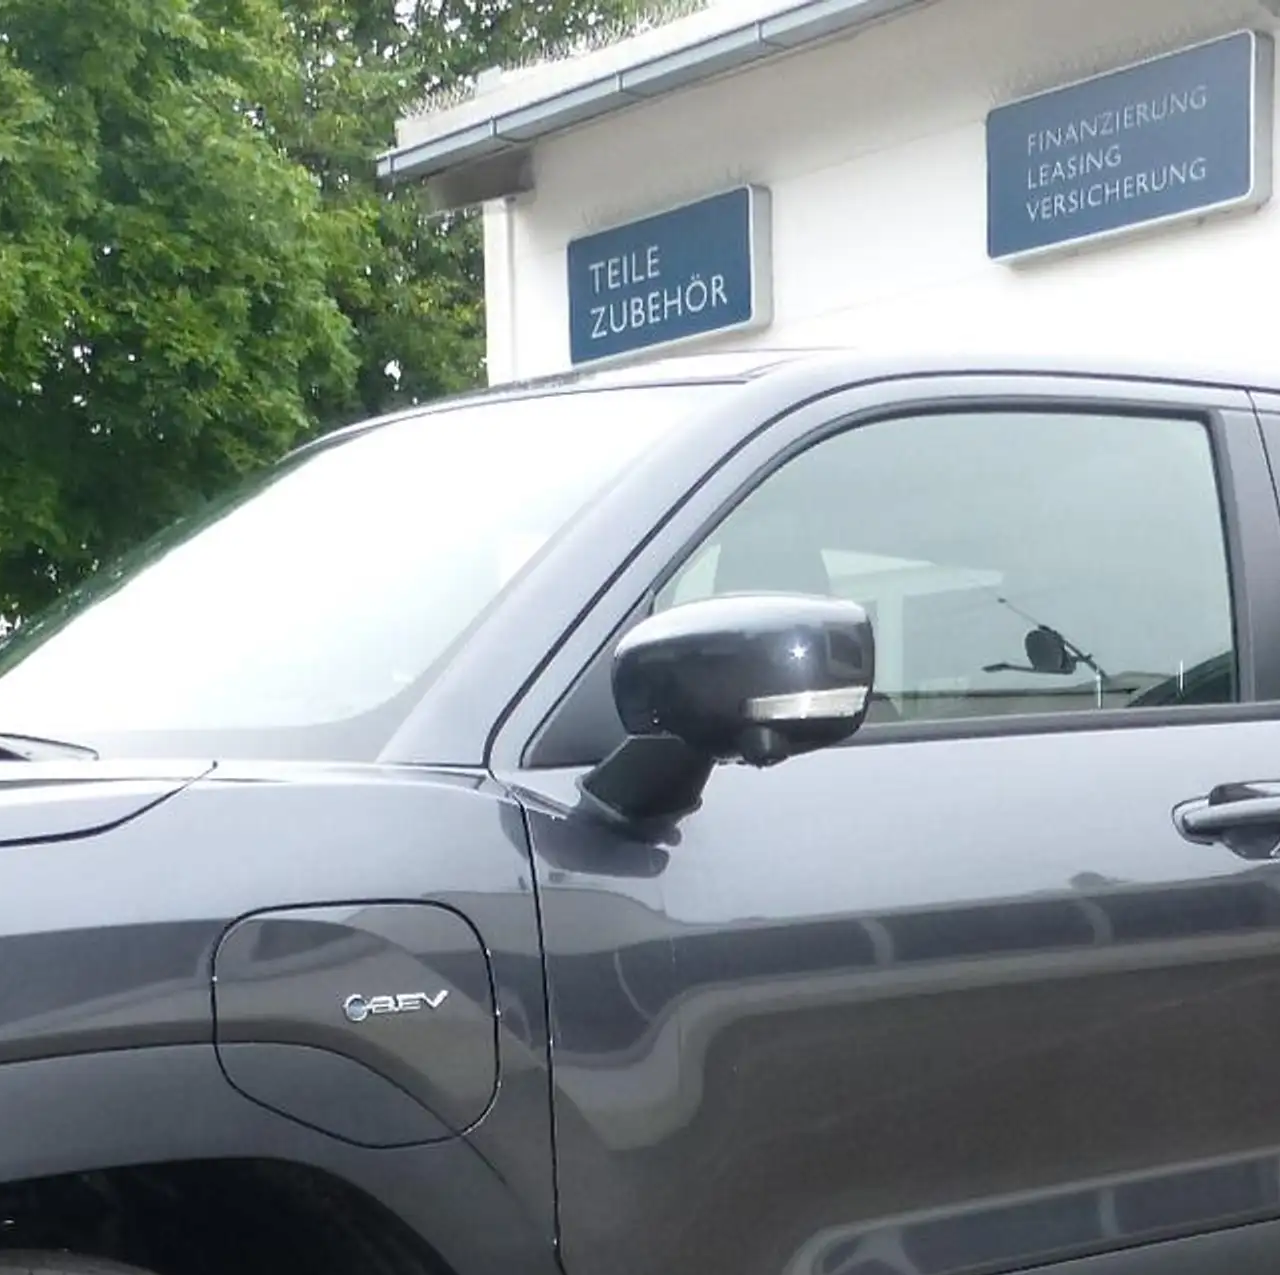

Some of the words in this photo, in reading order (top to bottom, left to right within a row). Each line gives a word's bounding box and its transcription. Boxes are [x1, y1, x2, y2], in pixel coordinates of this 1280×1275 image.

[1026, 85, 1207, 156] FINANZIERUNG
[1025, 157, 1207, 222] VERSICHERUNG
[1026, 145, 1122, 190] LEASING
[588, 244, 661, 294] TEILE
[589, 272, 728, 339] ZUBEHÖR
